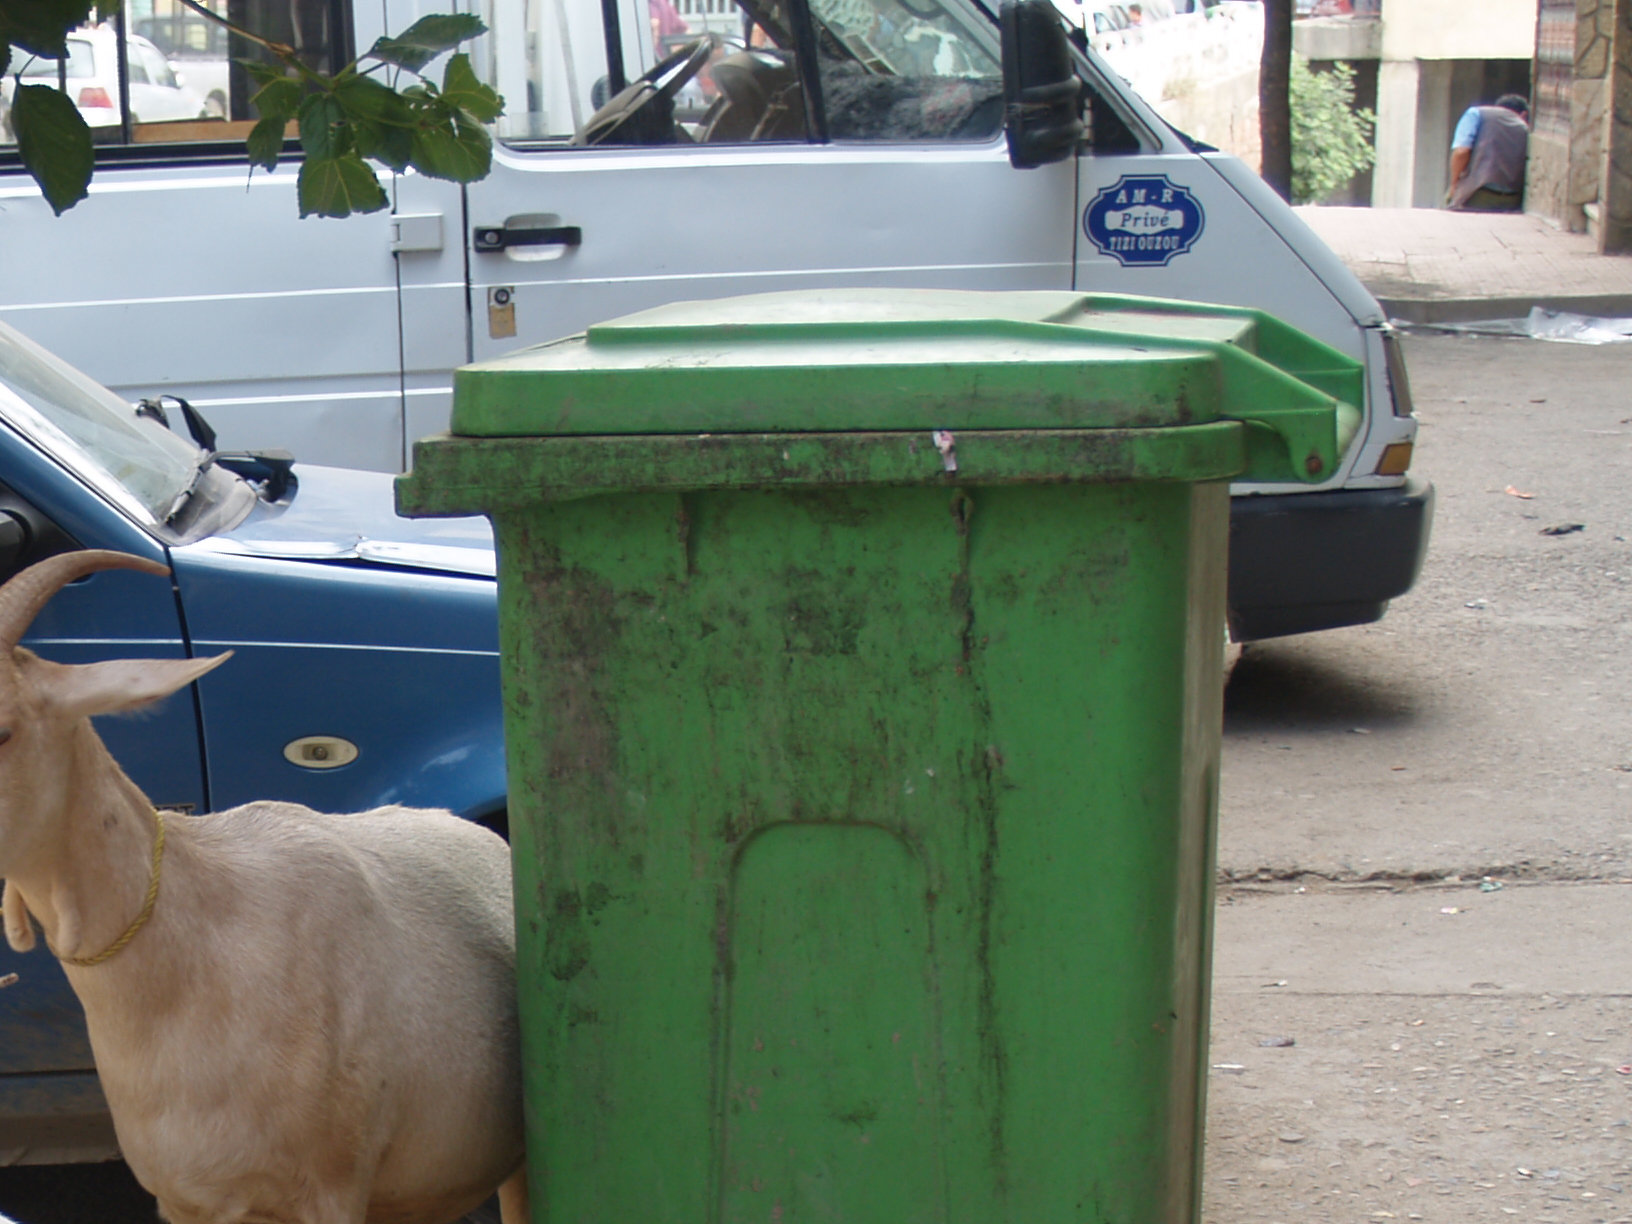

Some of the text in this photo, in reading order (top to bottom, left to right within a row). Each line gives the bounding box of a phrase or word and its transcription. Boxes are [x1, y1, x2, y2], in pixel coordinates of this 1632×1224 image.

[1120, 212, 1169, 227] Privé
[1109, 236, 1180, 250] TIZI OUZOU
